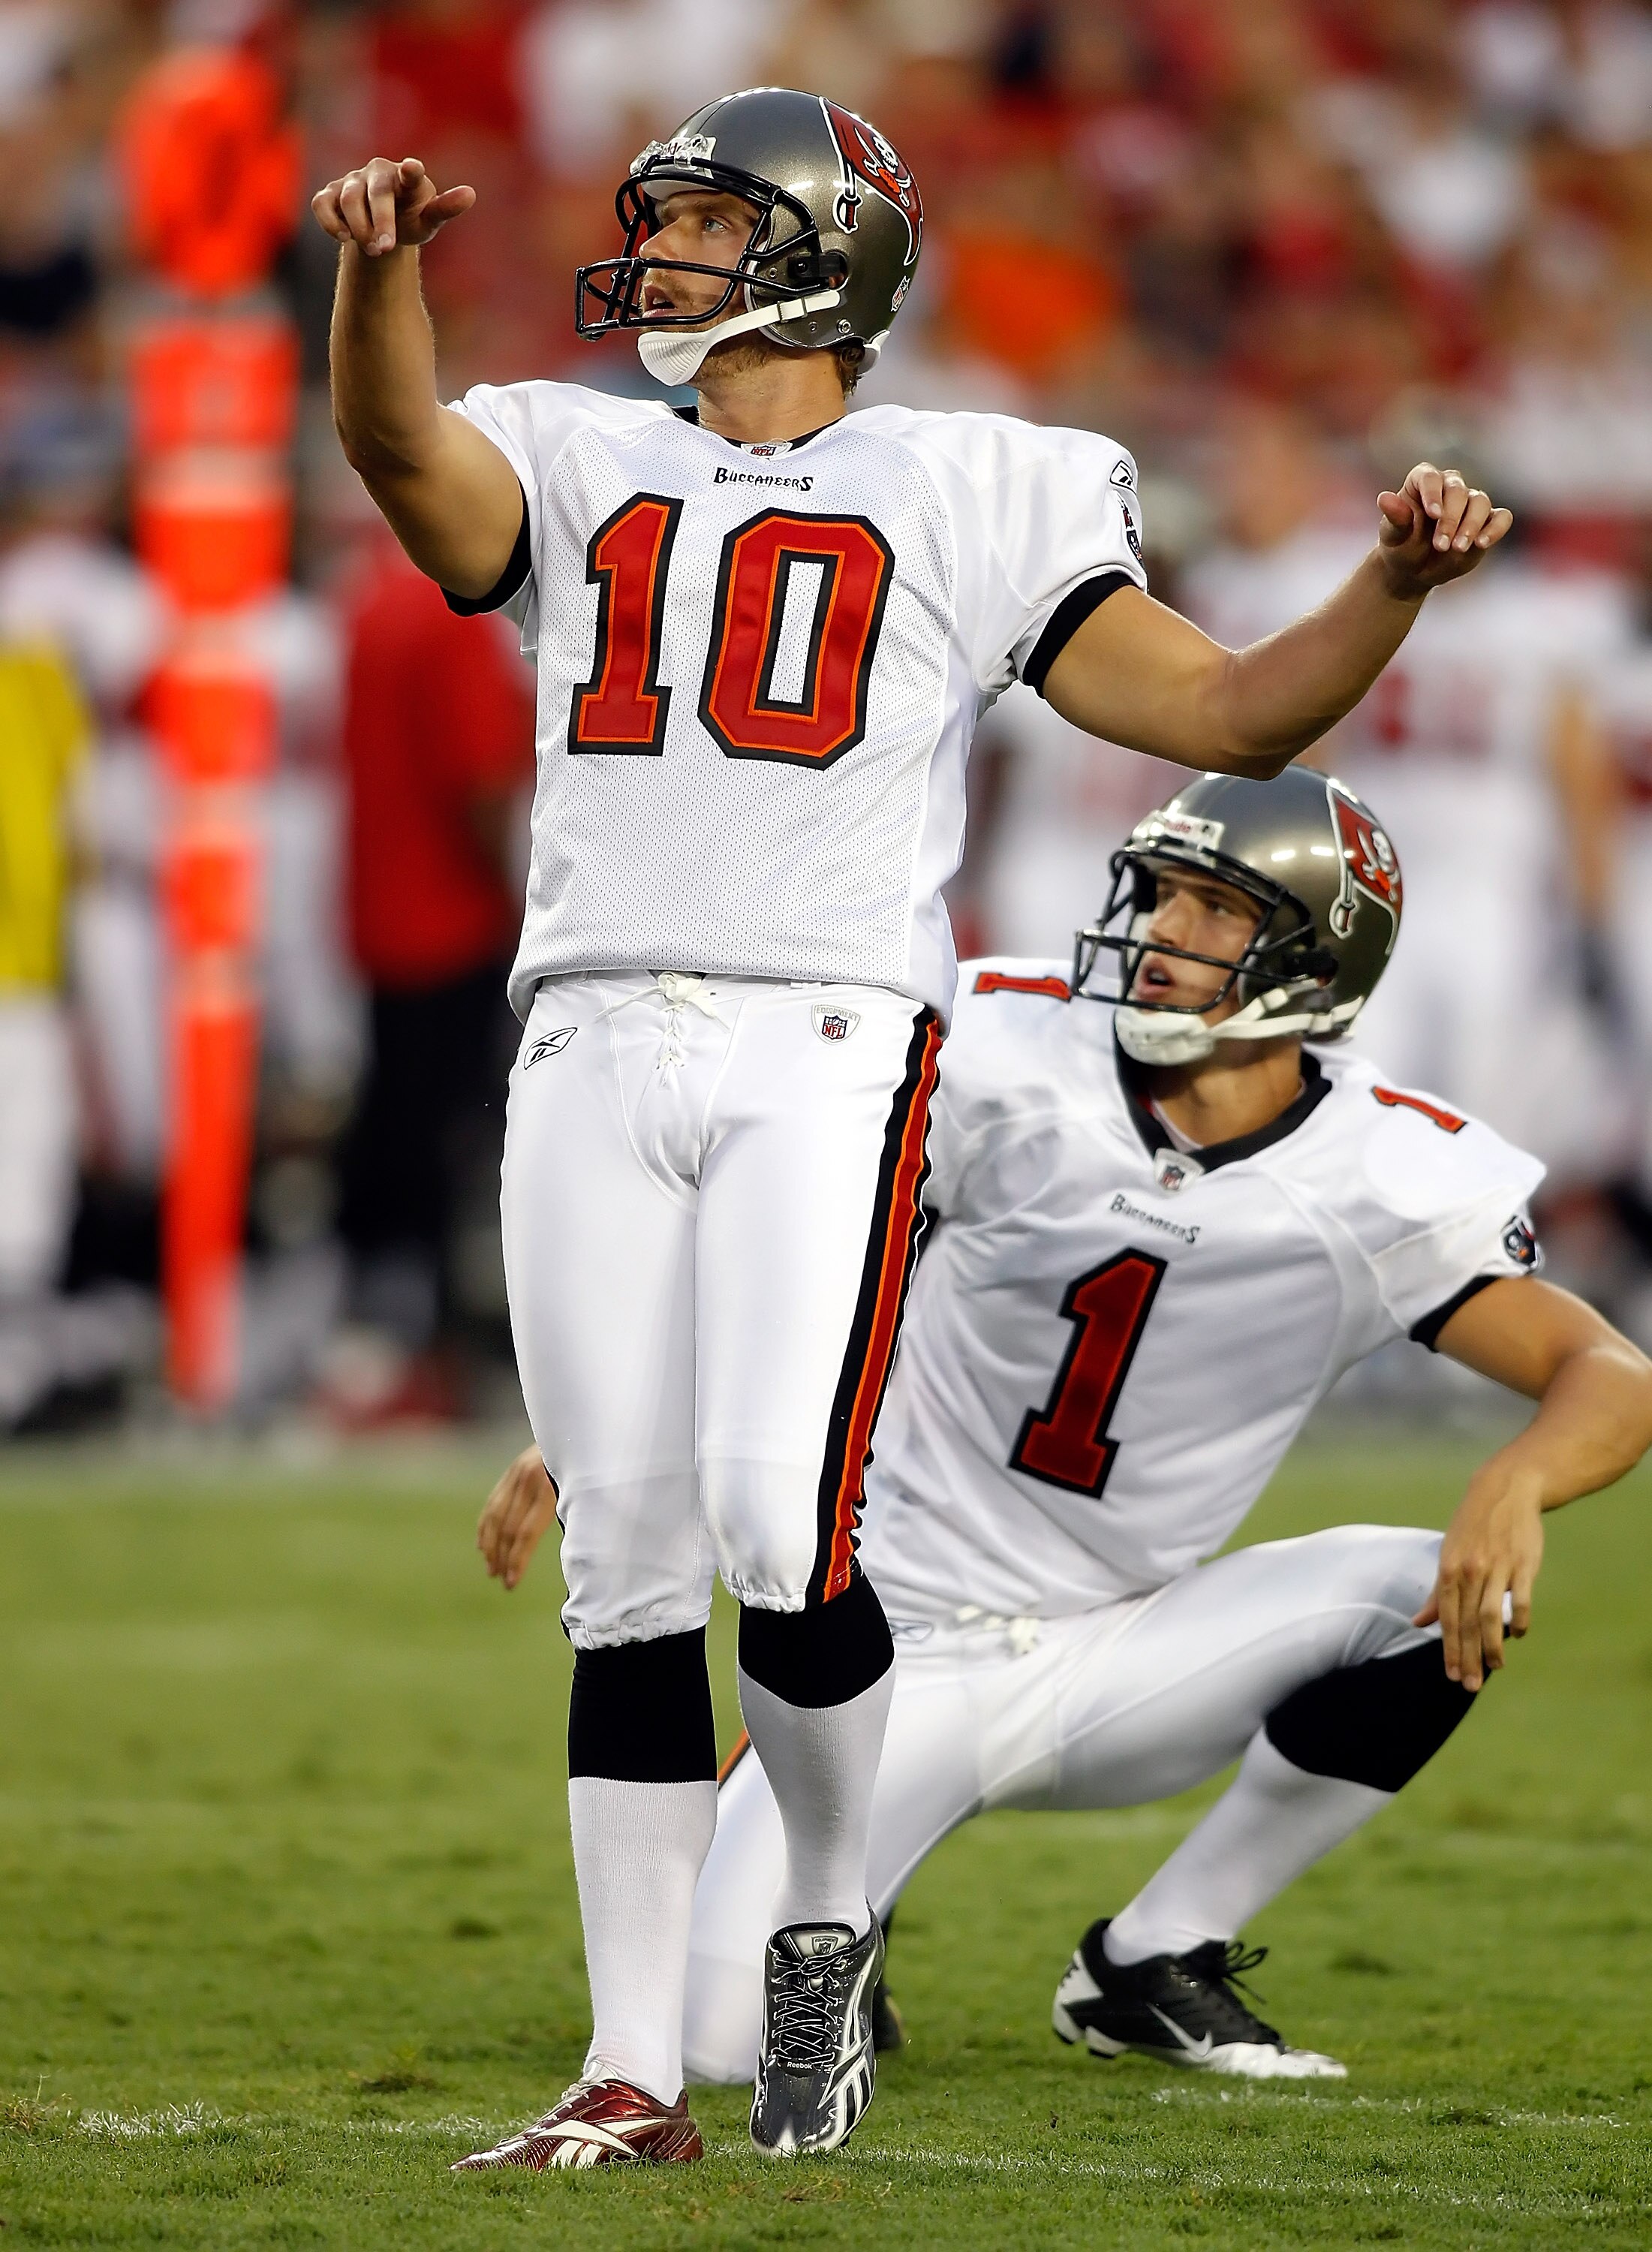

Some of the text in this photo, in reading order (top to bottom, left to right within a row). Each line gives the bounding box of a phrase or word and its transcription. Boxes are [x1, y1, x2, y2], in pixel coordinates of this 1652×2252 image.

[567, 492, 895, 771] 10
[973, 971, 1072, 1003] 1
[824, 1024, 843, 1037] NFL
[1370, 1085, 1468, 1134] 1
[1009, 1247, 1168, 1500] 1
[787, 2061, 813, 2070] Reebok
